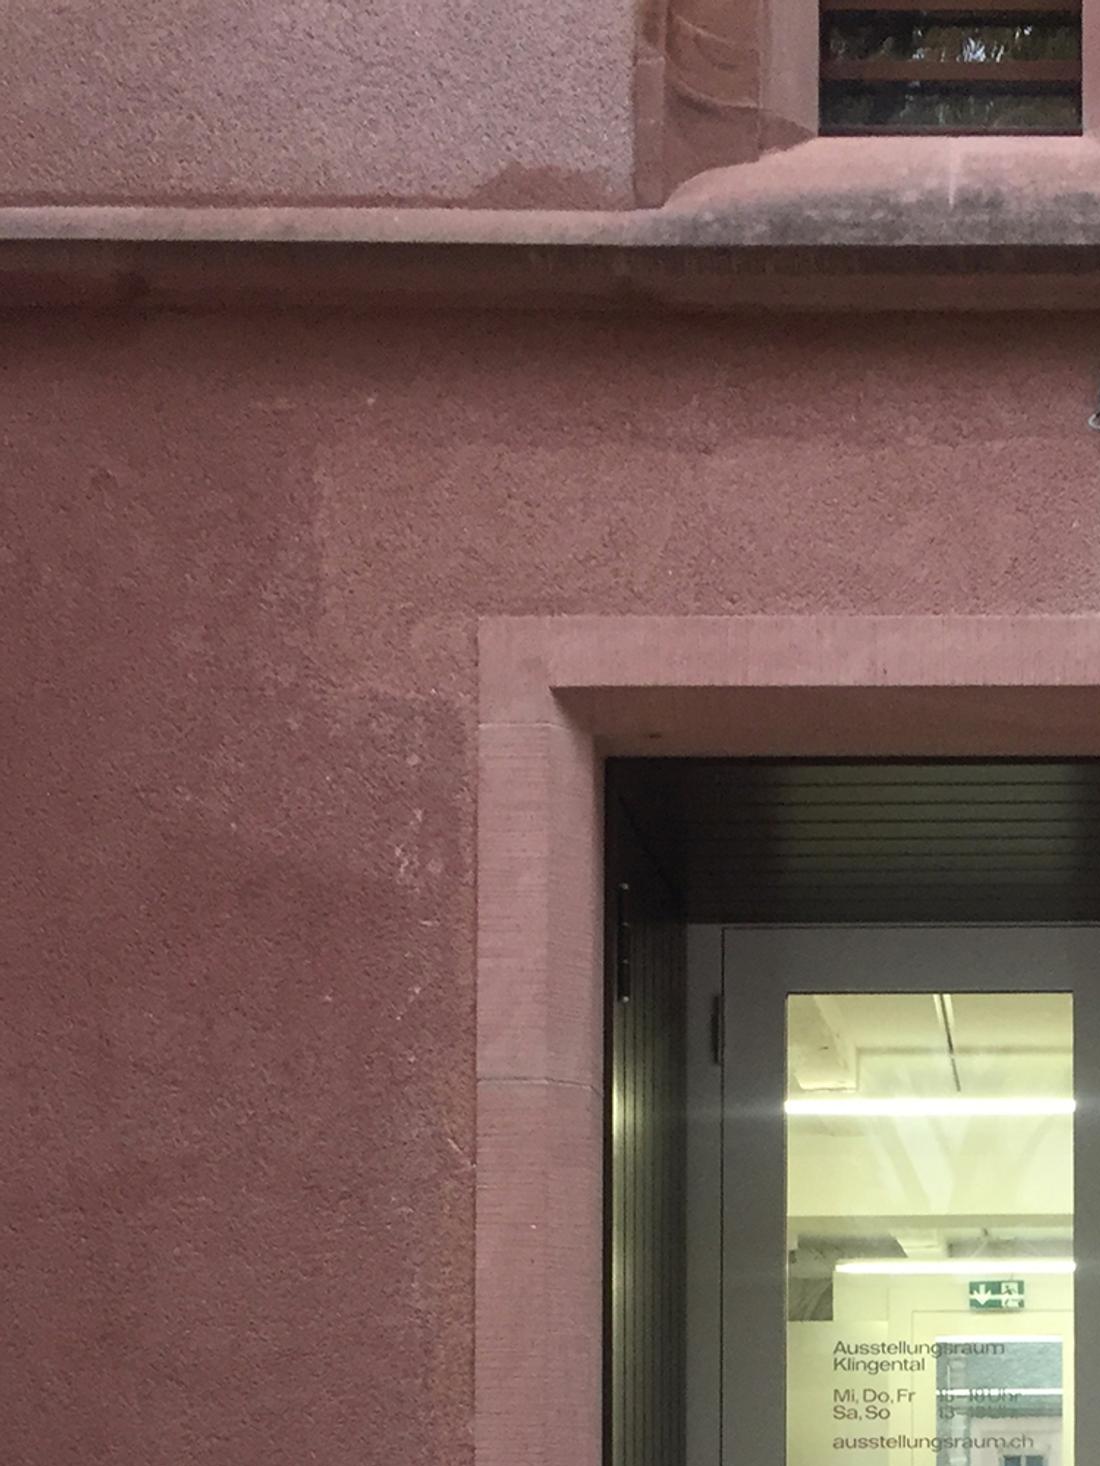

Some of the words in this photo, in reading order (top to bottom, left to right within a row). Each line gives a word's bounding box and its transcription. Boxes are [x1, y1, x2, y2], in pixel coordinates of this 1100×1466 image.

[833, 1340, 1005, 1359] Ausstellungsraum
[833, 1357, 925, 1375] Klingental
[833, 1388, 859, 1404] Mi,
[863, 1388, 894, 1404] Do,
[897, 1388, 916, 1403] Fr
[833, 1405, 862, 1421] Sa,
[865, 1405, 891, 1420] So
[833, 1434, 1034, 1452] ausstellungsraum.ch
